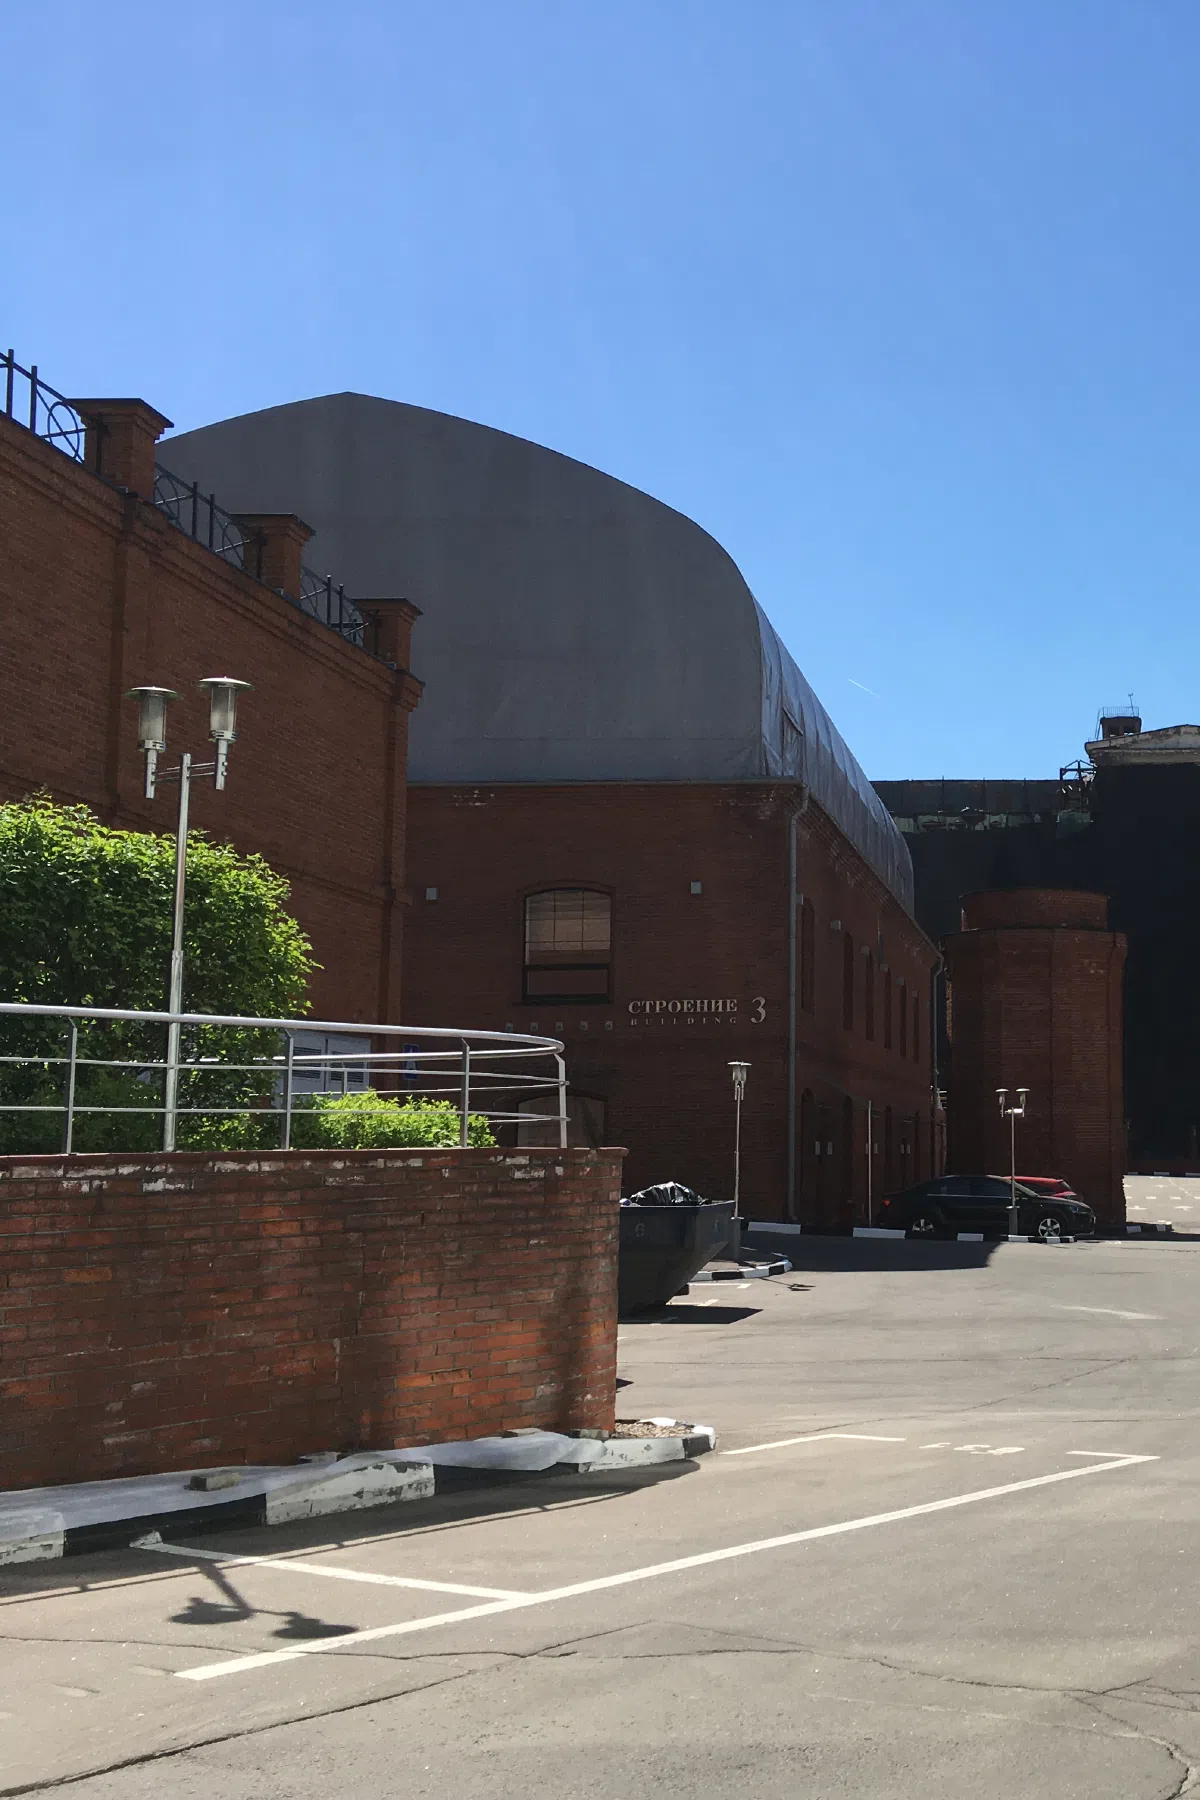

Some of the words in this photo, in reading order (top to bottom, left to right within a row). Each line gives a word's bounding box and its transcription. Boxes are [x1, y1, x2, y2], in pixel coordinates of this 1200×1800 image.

[628, 999, 738, 1014] СТРОЕНИЕ
[750, 996, 767, 1024] 3
[630, 1016, 737, 1026] BUILDING
